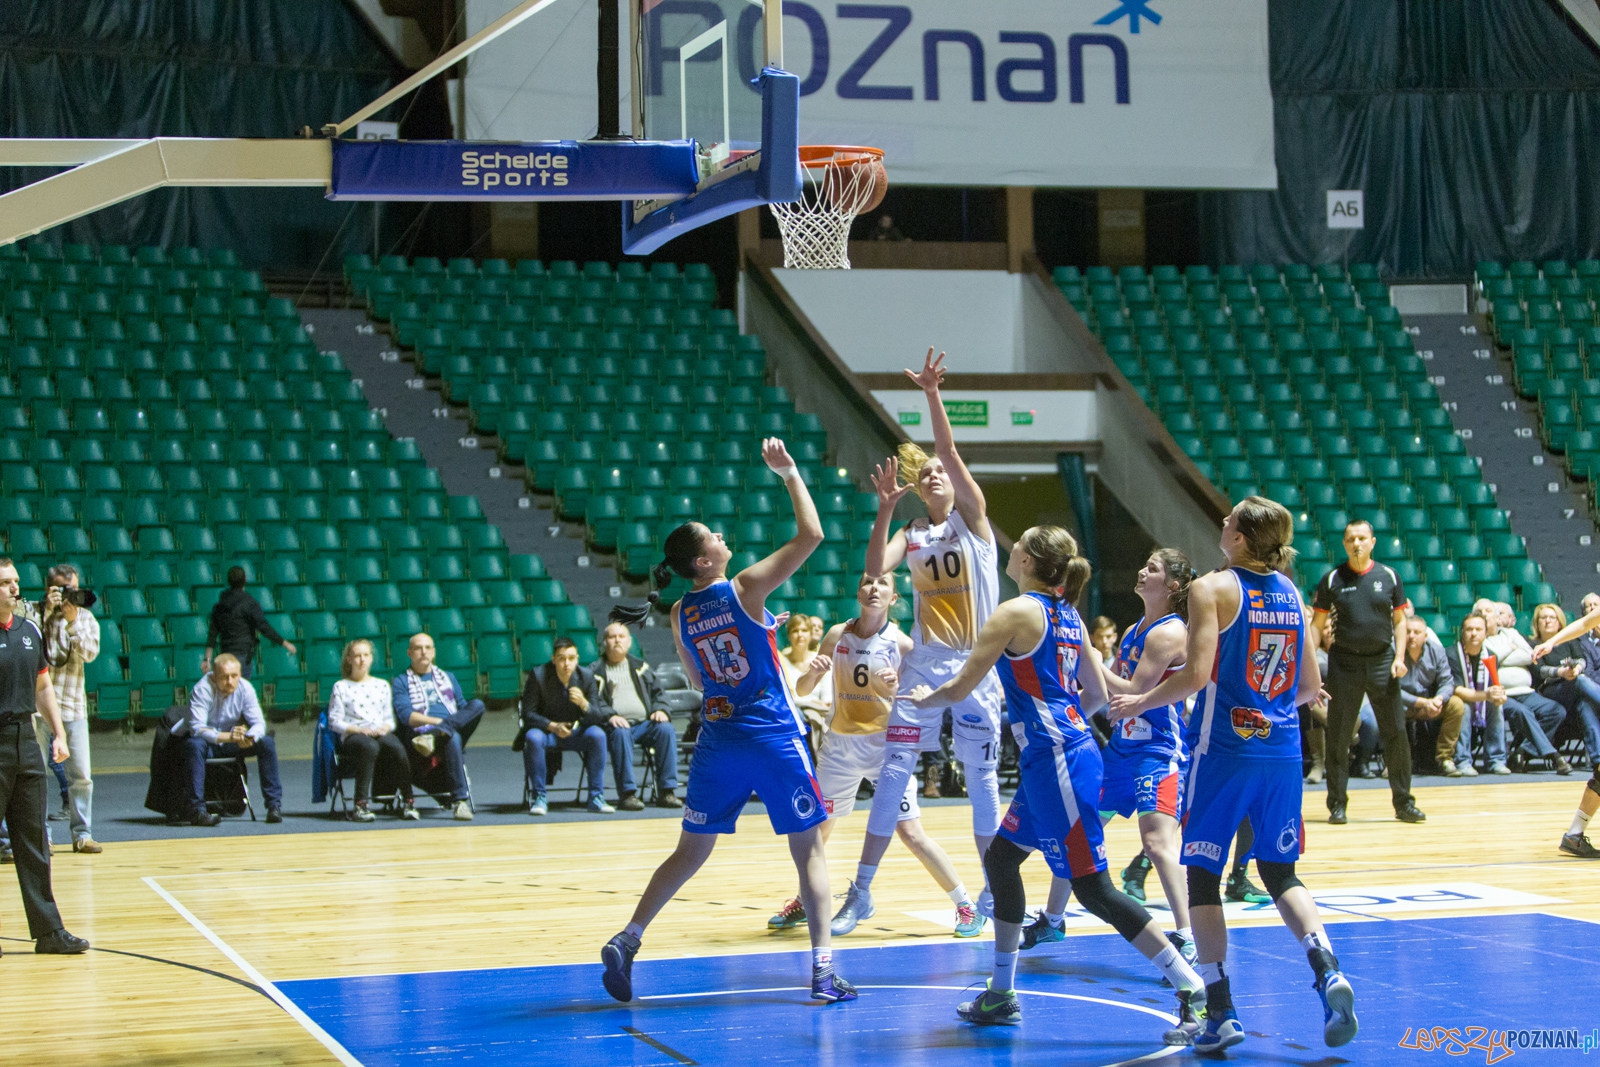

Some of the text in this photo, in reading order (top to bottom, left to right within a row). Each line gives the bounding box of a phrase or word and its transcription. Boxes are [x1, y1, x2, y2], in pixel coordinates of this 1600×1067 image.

[462, 151, 569, 169] Schelde
[462, 169, 569, 190] Sports
[1332, 200, 1359, 217] A6
[355, 324, 374, 334] 14
[380, 351, 398, 361] 13
[1501, 401, 1516, 411] 11
[432, 408, 448, 417] 11
[1514, 428, 1532, 437] 10
[458, 437, 477, 447] 10
[1564, 509, 1575, 519] 7
[548, 526, 560, 536] 7
[925, 551, 961, 581] 10
[1264, 592, 1296, 604] STRUS
[700, 596, 729, 613] STRUS
[695, 631, 750, 683] 13
[1259, 632, 1288, 693] 7
[853, 664, 869, 688] 6
[889, 727, 919, 736] TAURON
[1198, 842, 1220, 853] ETIS
